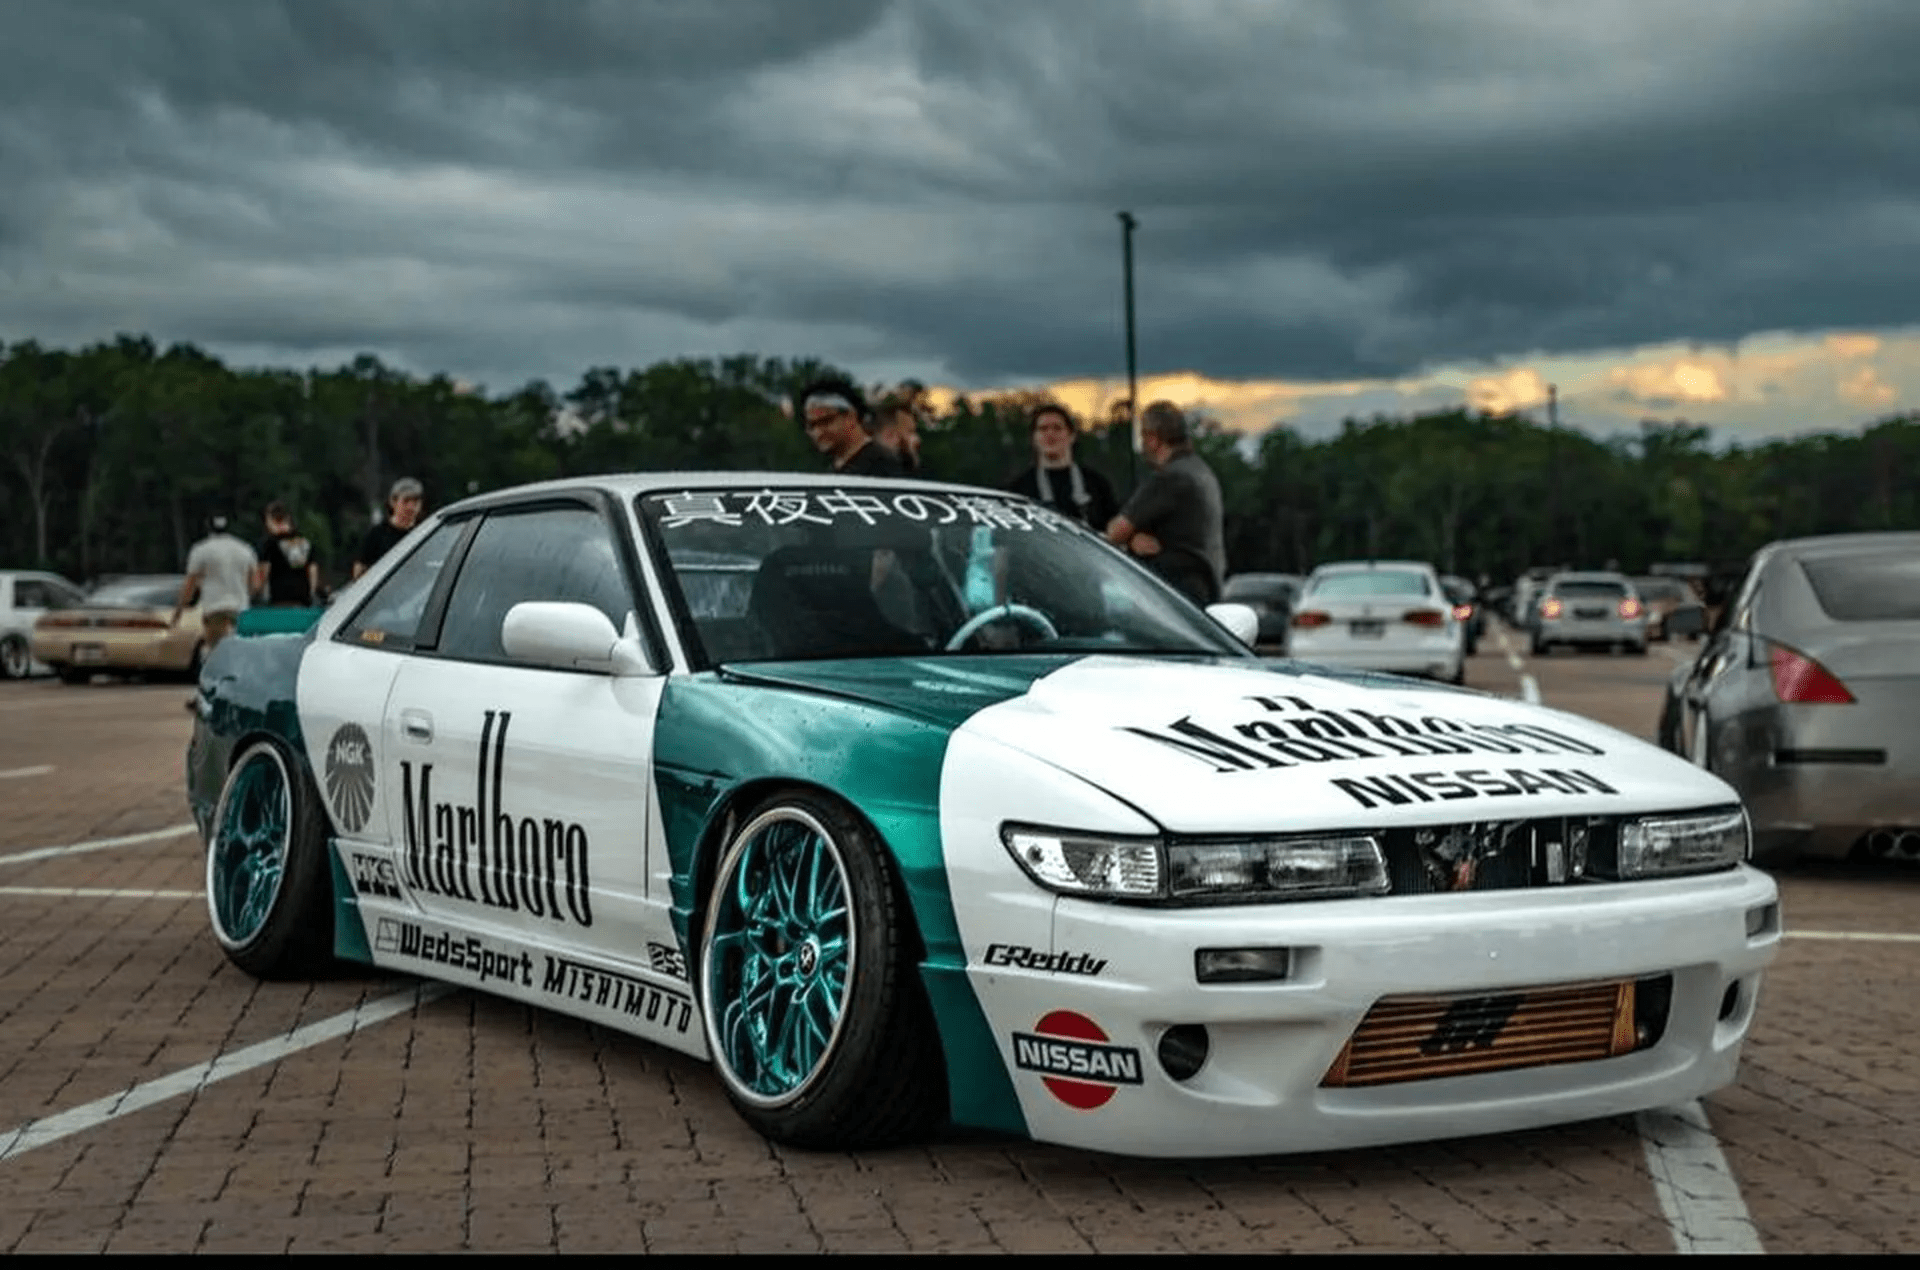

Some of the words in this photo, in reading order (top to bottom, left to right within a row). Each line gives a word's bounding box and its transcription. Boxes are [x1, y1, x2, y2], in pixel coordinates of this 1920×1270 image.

[335, 741, 365, 766] NGK
[1112, 696, 1606, 773] Marlboro
[1330, 768, 1620, 809] NISSAN
[400, 710, 593, 927] Marlboro
[352, 853, 402, 900] HKS
[400, 923, 533, 987] WedsSport
[543, 955, 693, 1035] MISHIMOTO
[984, 943, 1108, 976] GReddy
[1017, 1038, 1138, 1079] NISSAN
